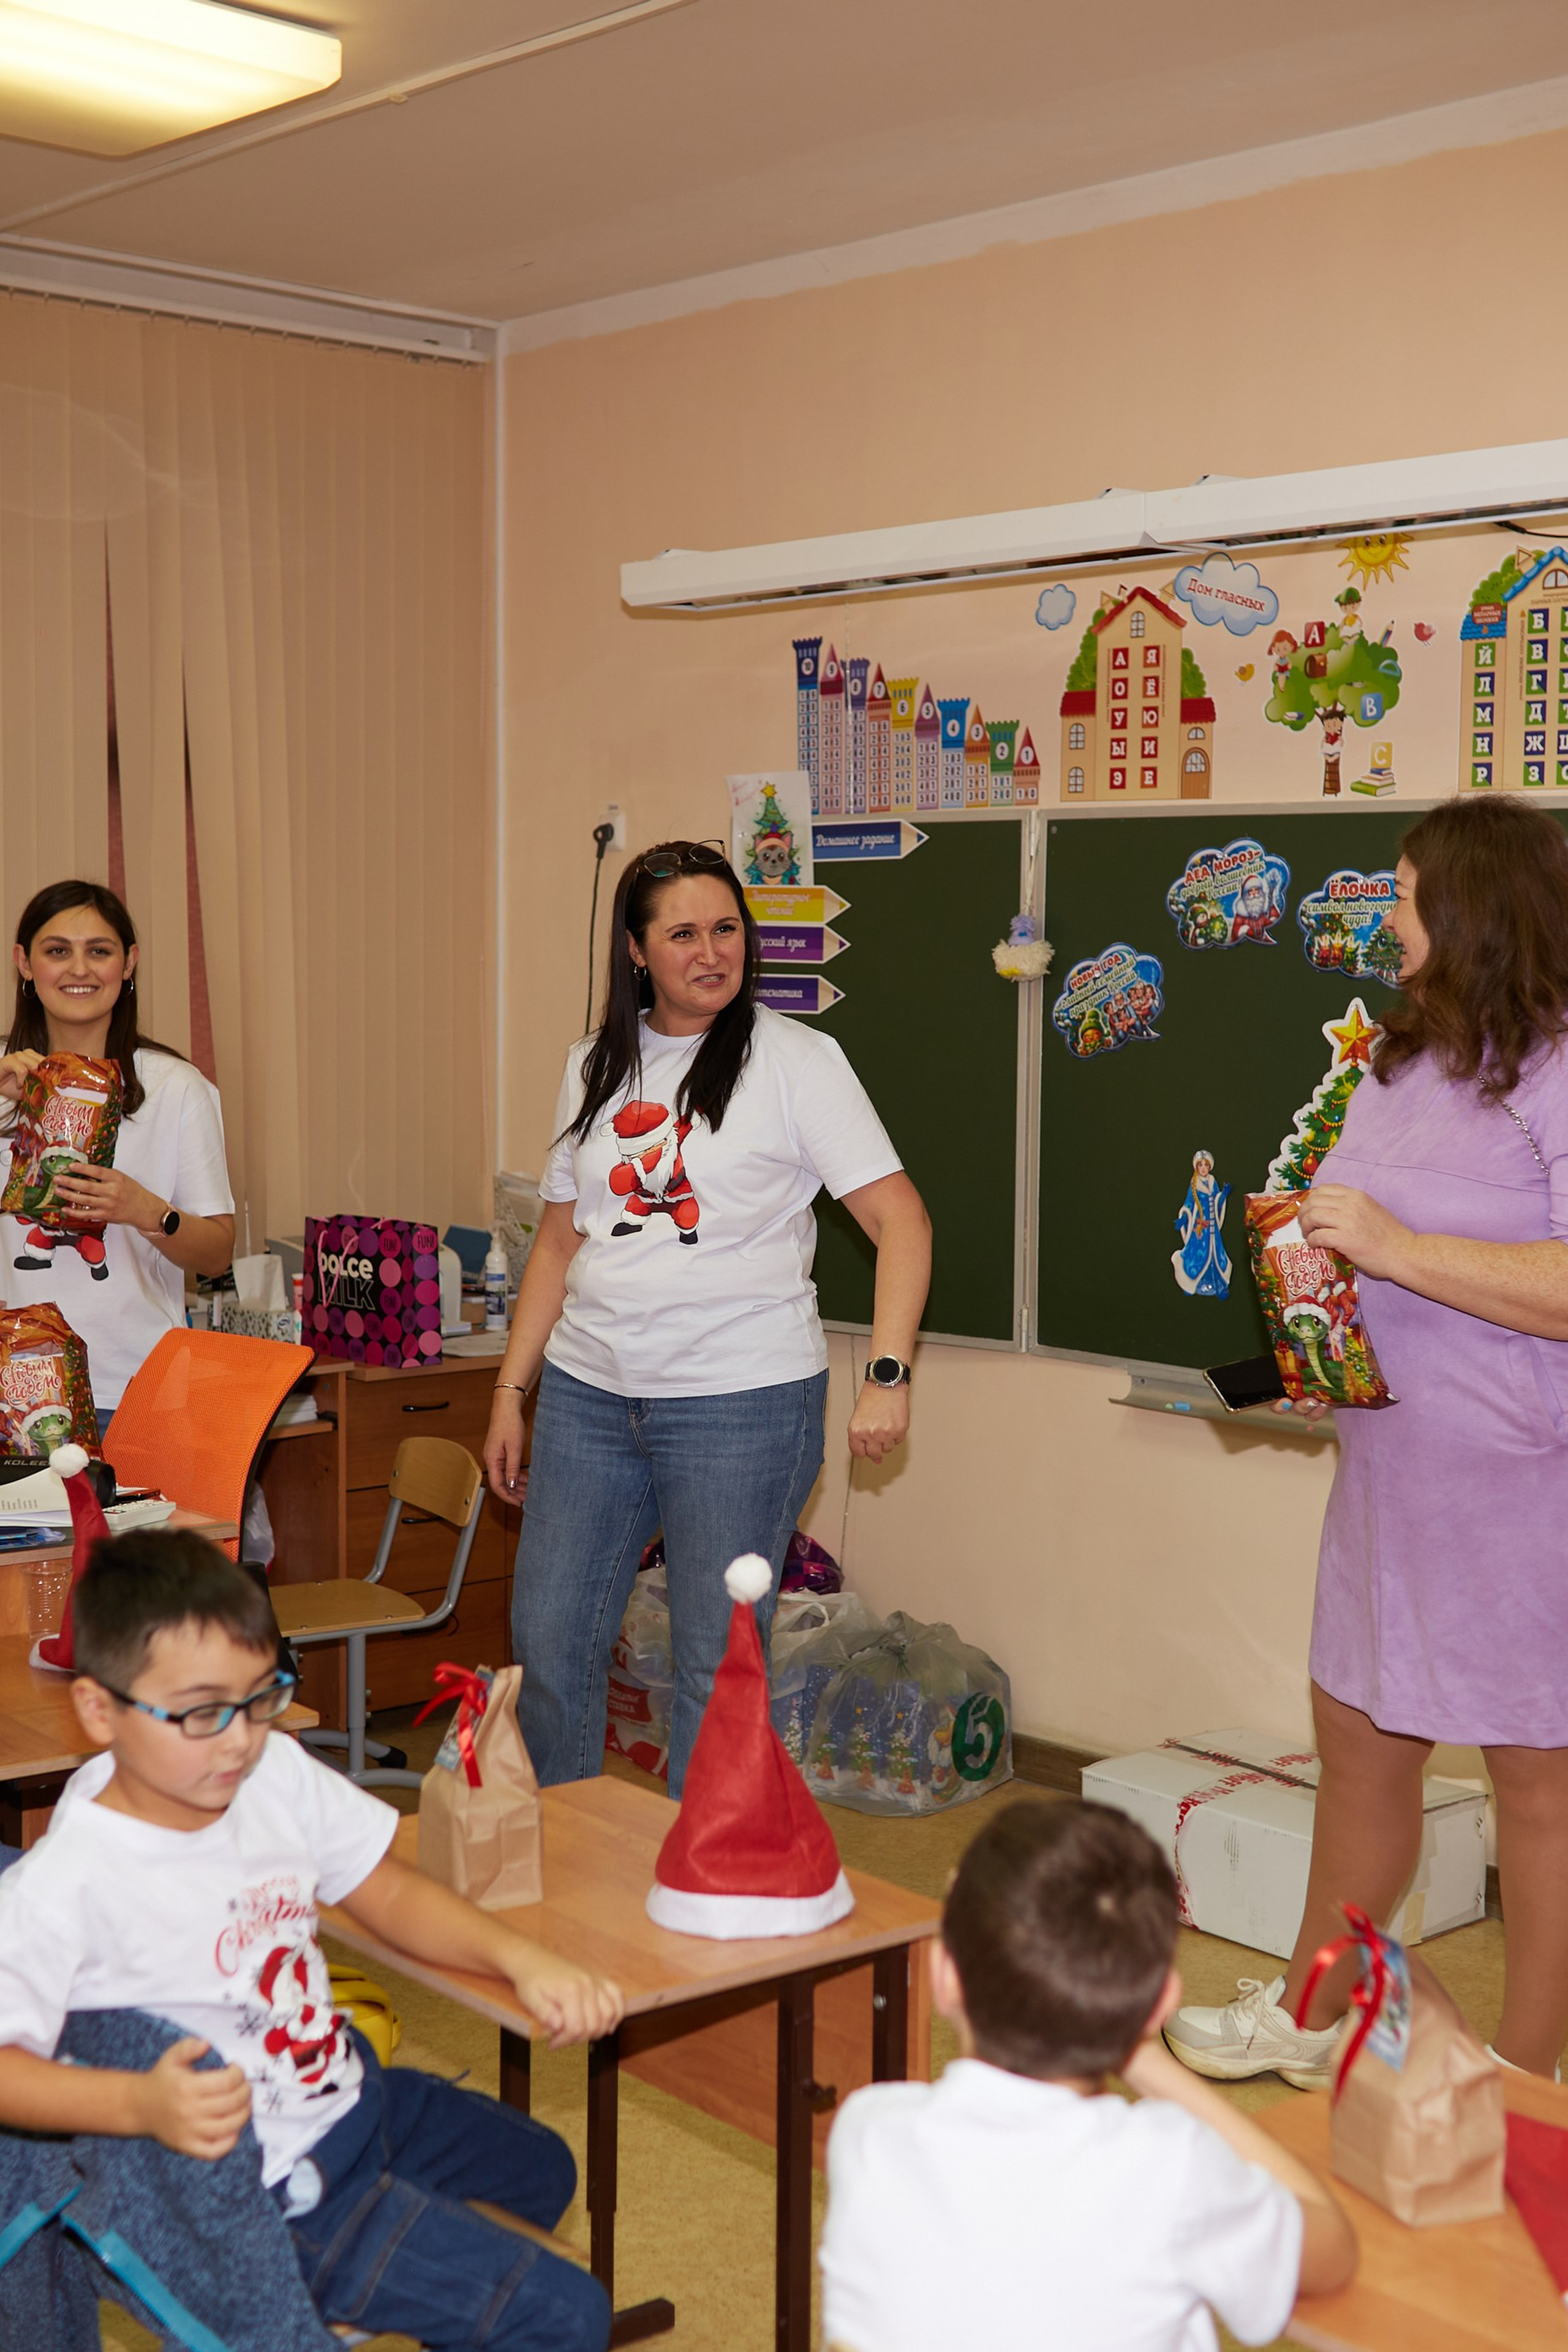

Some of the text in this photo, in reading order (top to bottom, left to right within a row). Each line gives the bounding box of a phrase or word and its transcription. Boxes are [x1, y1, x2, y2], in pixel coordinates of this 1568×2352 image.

[1188, 578, 1265, 612] Дом гласных
[1532, 612, 1544, 629] Б
[1308, 624, 1321, 644] A
[1114, 649, 1157, 666] А Я
[1478, 645, 1493, 665] Й
[1531, 644, 1544, 660] В
[804, 661, 811, 671] 10
[829, 665, 834, 674] 9
[853, 682, 858, 692] 8
[877, 685, 881, 695] 7
[1114, 678, 1156, 696] О Ё
[1477, 676, 1491, 693] Л
[1531, 674, 1542, 690] Г
[900, 703, 905, 713] 6
[925, 705, 930, 716] 5
[1365, 697, 1377, 717] B
[1476, 706, 1491, 723] М
[1529, 703, 1543, 722] Д
[1114, 710, 1158, 726] У Ю
[951, 723, 956, 732] 4
[975, 727, 980, 737] 3
[1000, 745, 1005, 756] 2
[1112, 740, 1156, 755] Ы И
[1476, 736, 1490, 753] Н
[1526, 735, 1544, 752] Ж
[1025, 750, 1029, 760] 1
[1374, 745, 1387, 765] C
[1113, 771, 1154, 785] Э Е
[1476, 766, 1488, 783] Р
[1529, 765, 1539, 782] З
[1181, 862, 1265, 900] добрый волшебник
[1185, 866, 1210, 884] ДЕД
[1207, 878, 1243, 899] России!
[1330, 880, 1390, 897] ЁЛОЧКА
[1308, 899, 1345, 913] символ
[1343, 913, 1372, 928] чуда!
[760, 936, 807, 952] усский язык
[1103, 954, 1121, 969] ГОД
[1061, 957, 1135, 1008] главный семейный
[1069, 989, 1109, 1019] праздник
[383, 1238, 397, 1251] FUN!
[418, 1234, 434, 1249] FUN!
